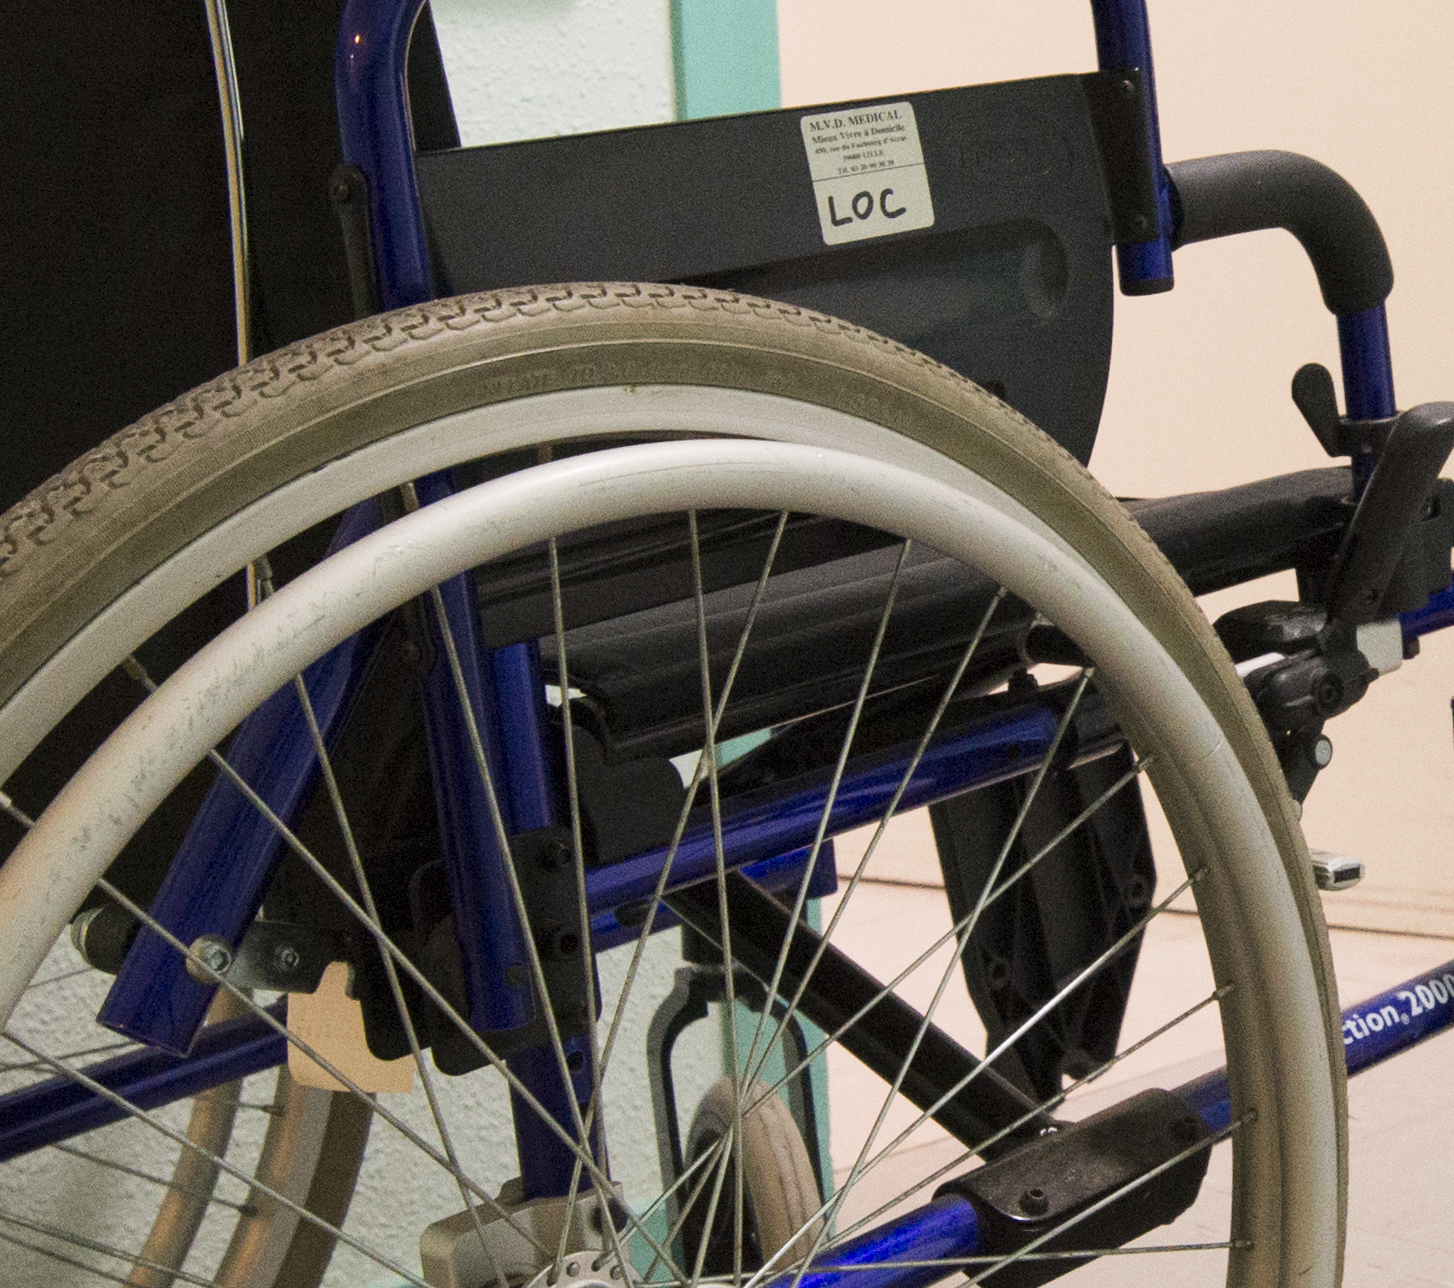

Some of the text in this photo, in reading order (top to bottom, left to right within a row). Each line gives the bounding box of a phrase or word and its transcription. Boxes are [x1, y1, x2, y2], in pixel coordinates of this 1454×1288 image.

[809, 110, 902, 132] M.V.D. MEDICAL
[811, 133, 838, 144] Mieux
[840, 130, 862, 140] Vivre
[871, 123, 905, 135] Domicile
[827, 188, 907, 227] LOC
[1342, 1007, 1400, 1046] ction
